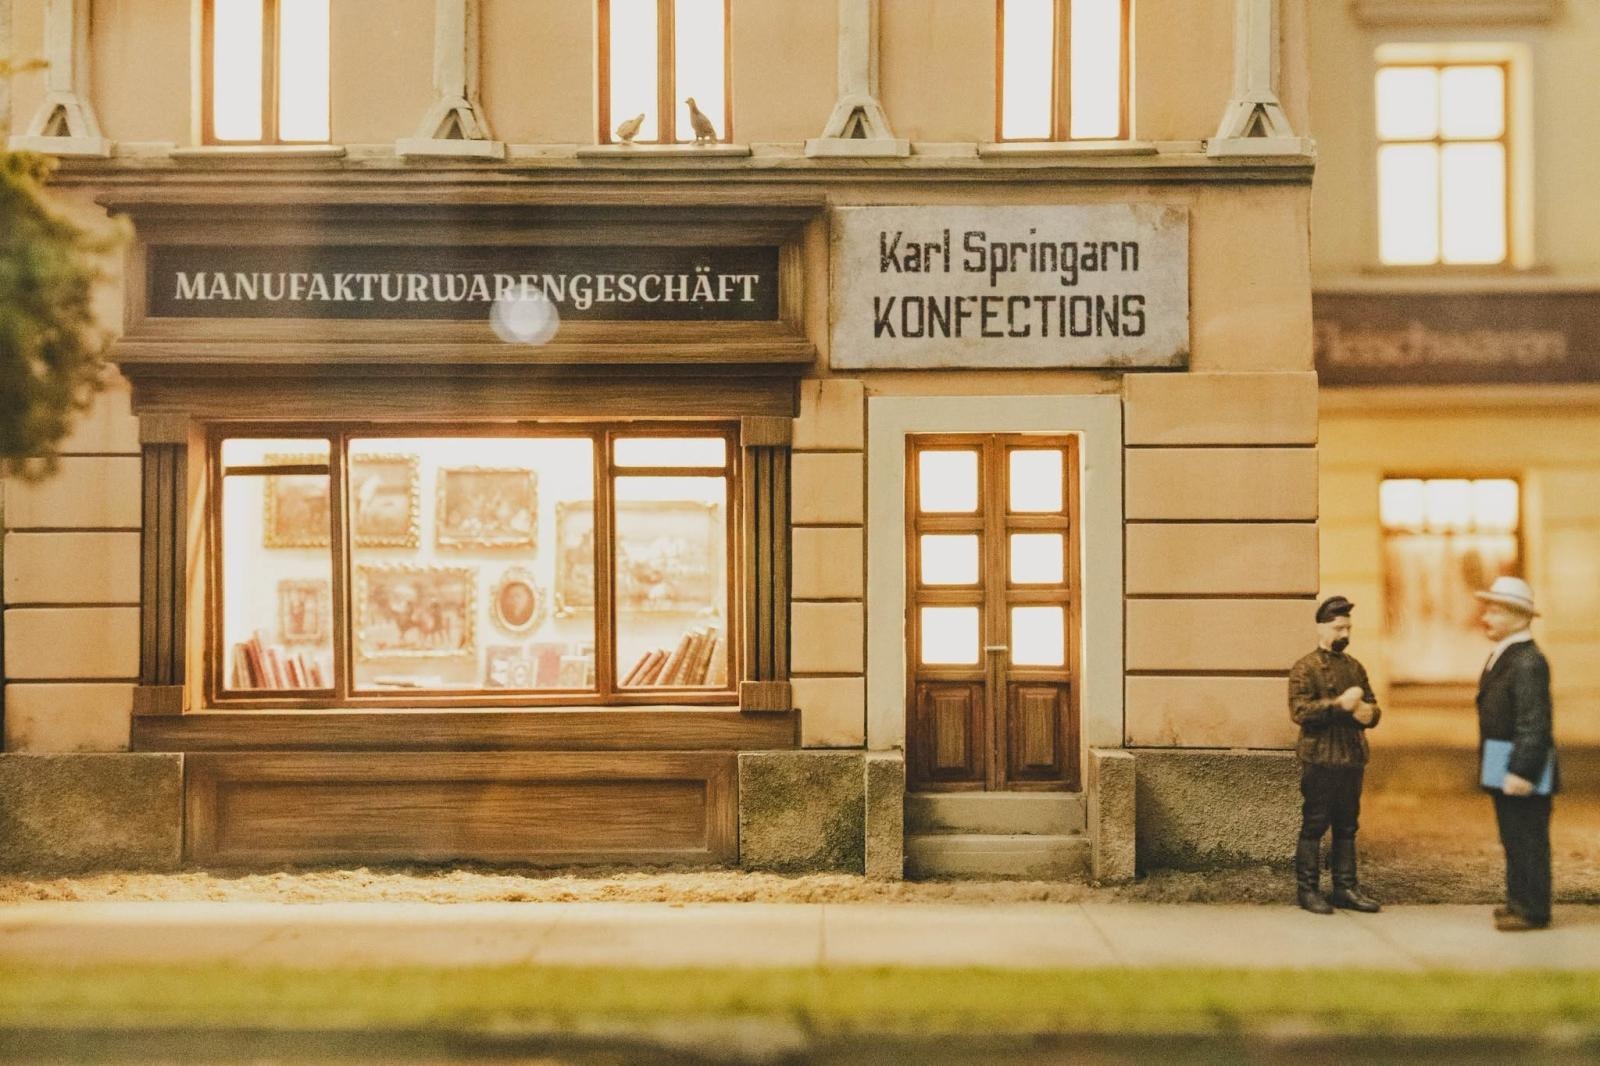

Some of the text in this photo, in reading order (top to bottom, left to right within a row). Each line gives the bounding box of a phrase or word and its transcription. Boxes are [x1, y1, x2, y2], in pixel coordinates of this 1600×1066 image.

[879, 228, 1139, 287] Karl Springarn
[174, 266, 760, 310] MANUFAKTURWARENGESCHÄFT
[873, 294, 1146, 338] KONFECTIONS
